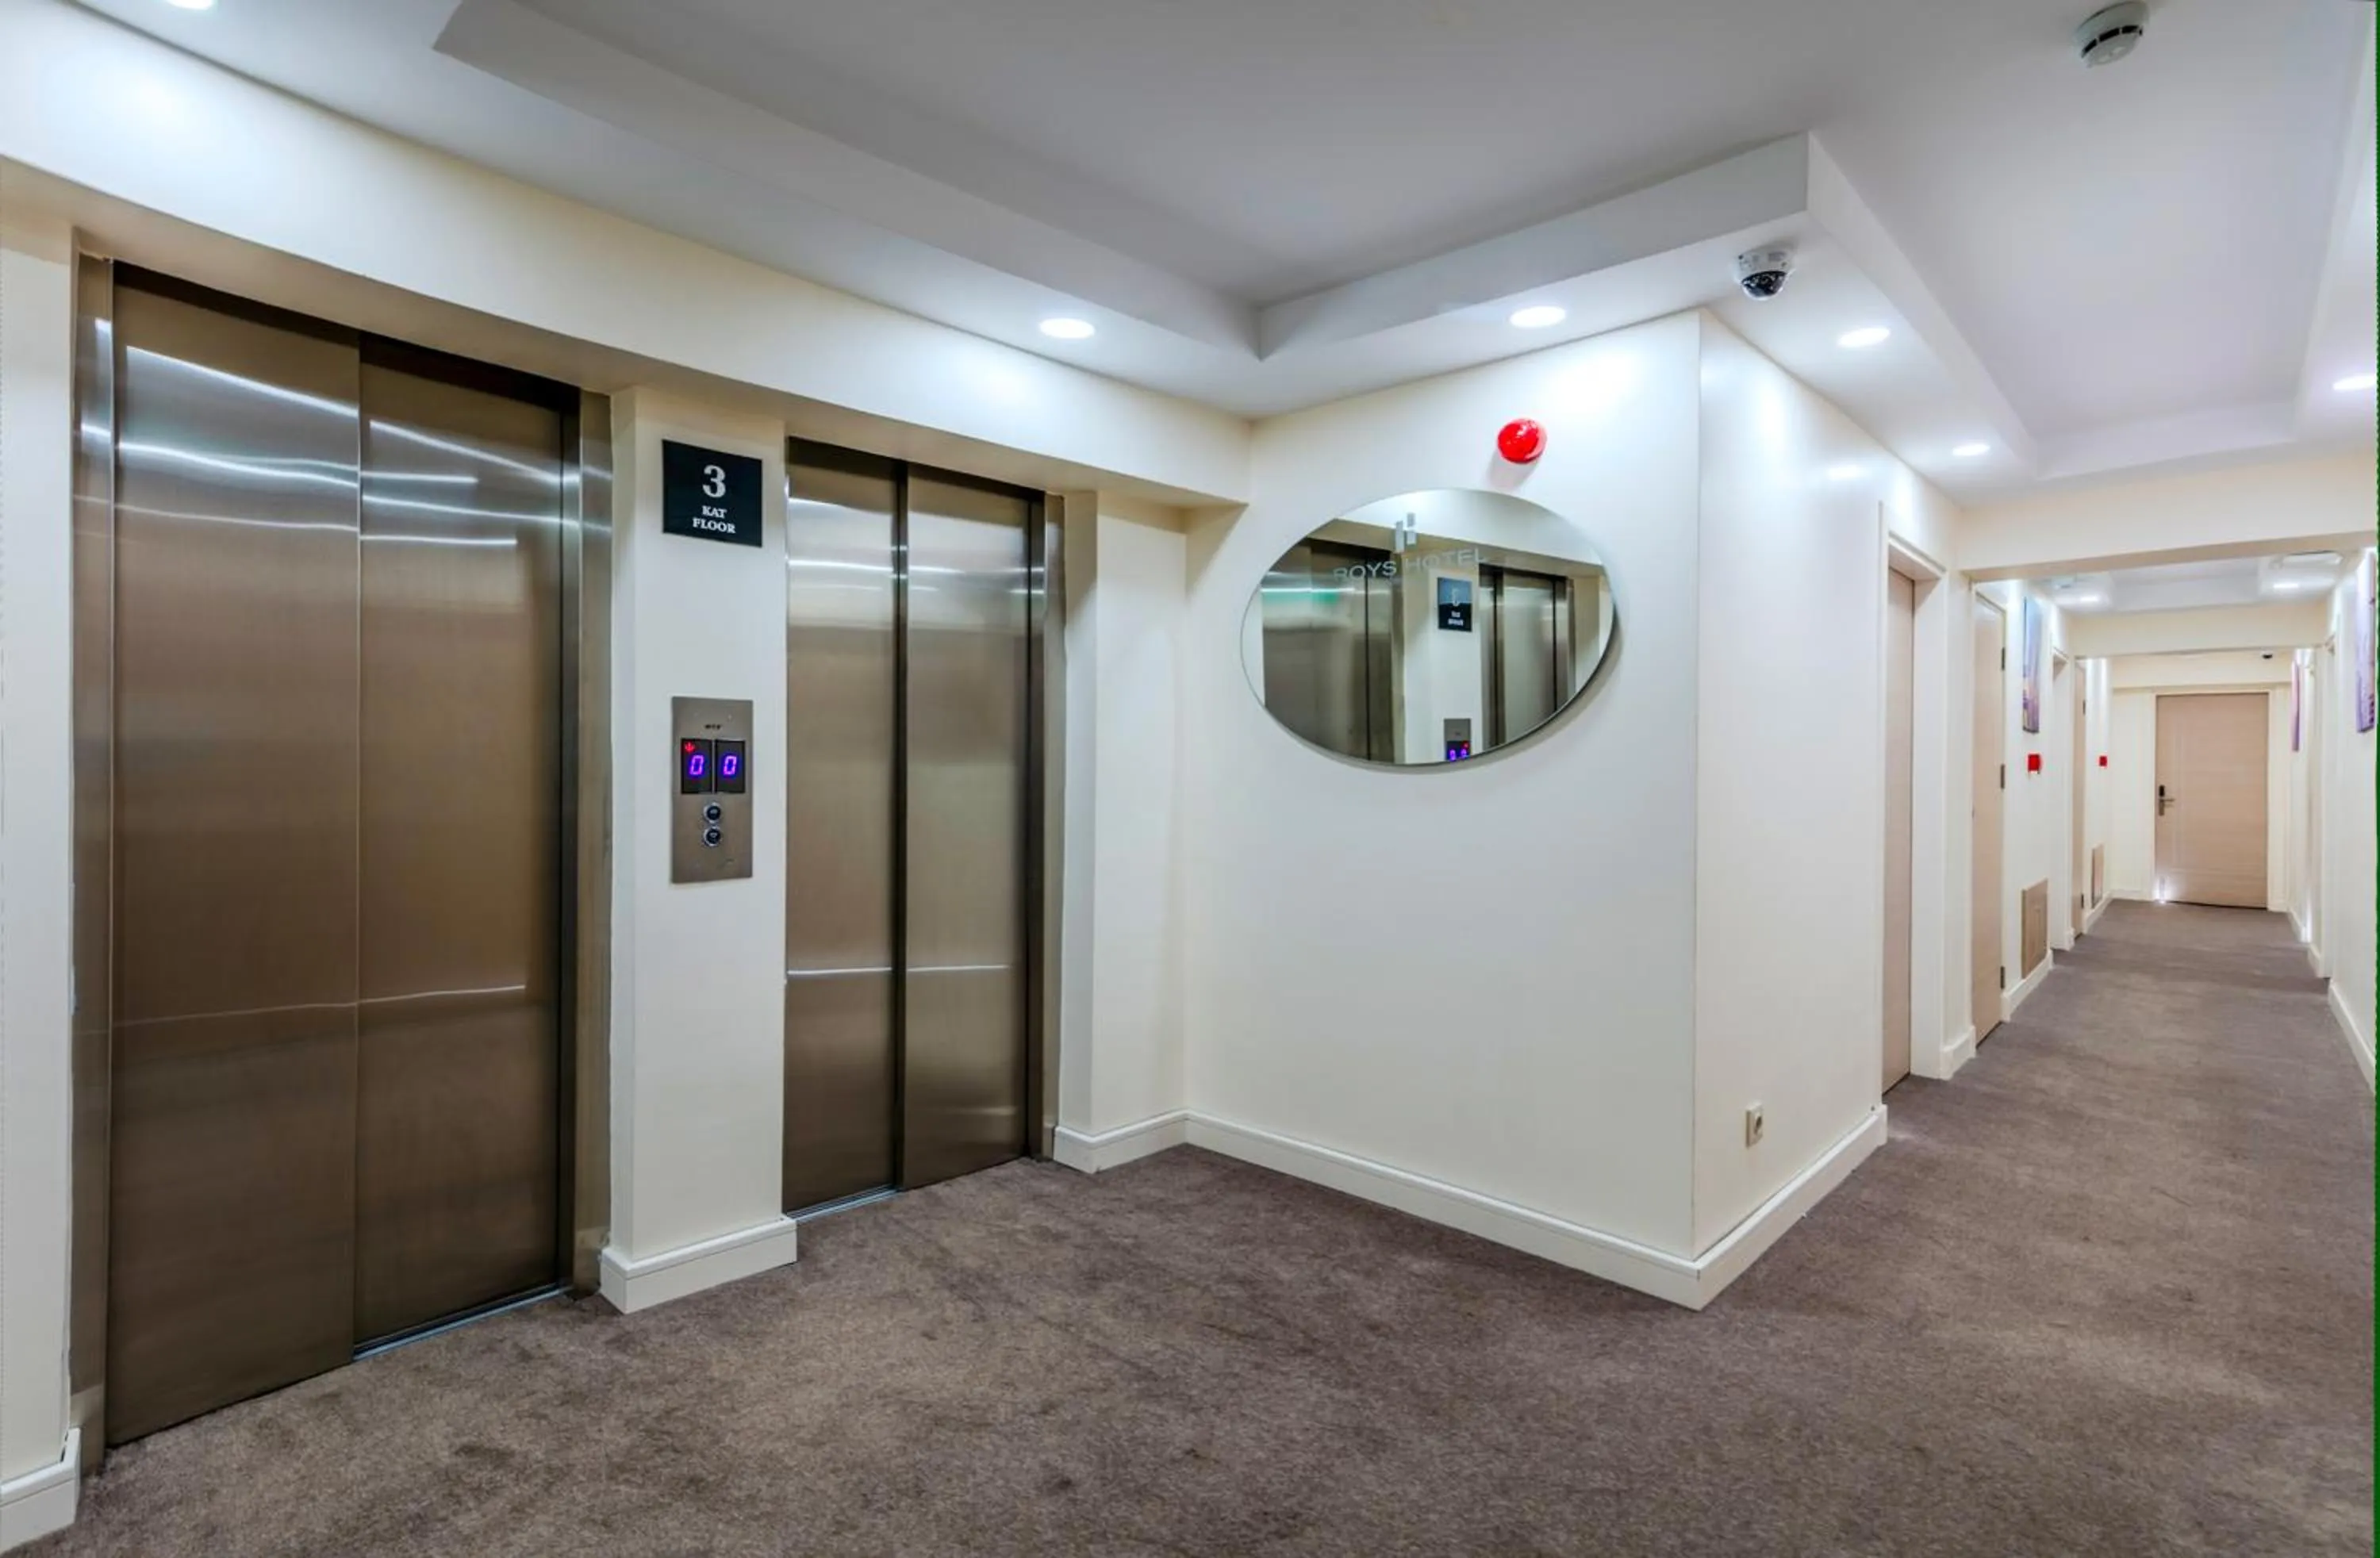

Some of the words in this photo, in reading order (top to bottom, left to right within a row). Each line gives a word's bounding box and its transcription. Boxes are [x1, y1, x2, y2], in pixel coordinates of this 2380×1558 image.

[702, 465, 727, 498] 3
[702, 505, 727, 518] KAT
[693, 517, 736, 533] FLOOR
[1405, 547, 1488, 571] HOTEL
[689, 755, 704, 776] 0
[724, 756, 737, 776] 0
